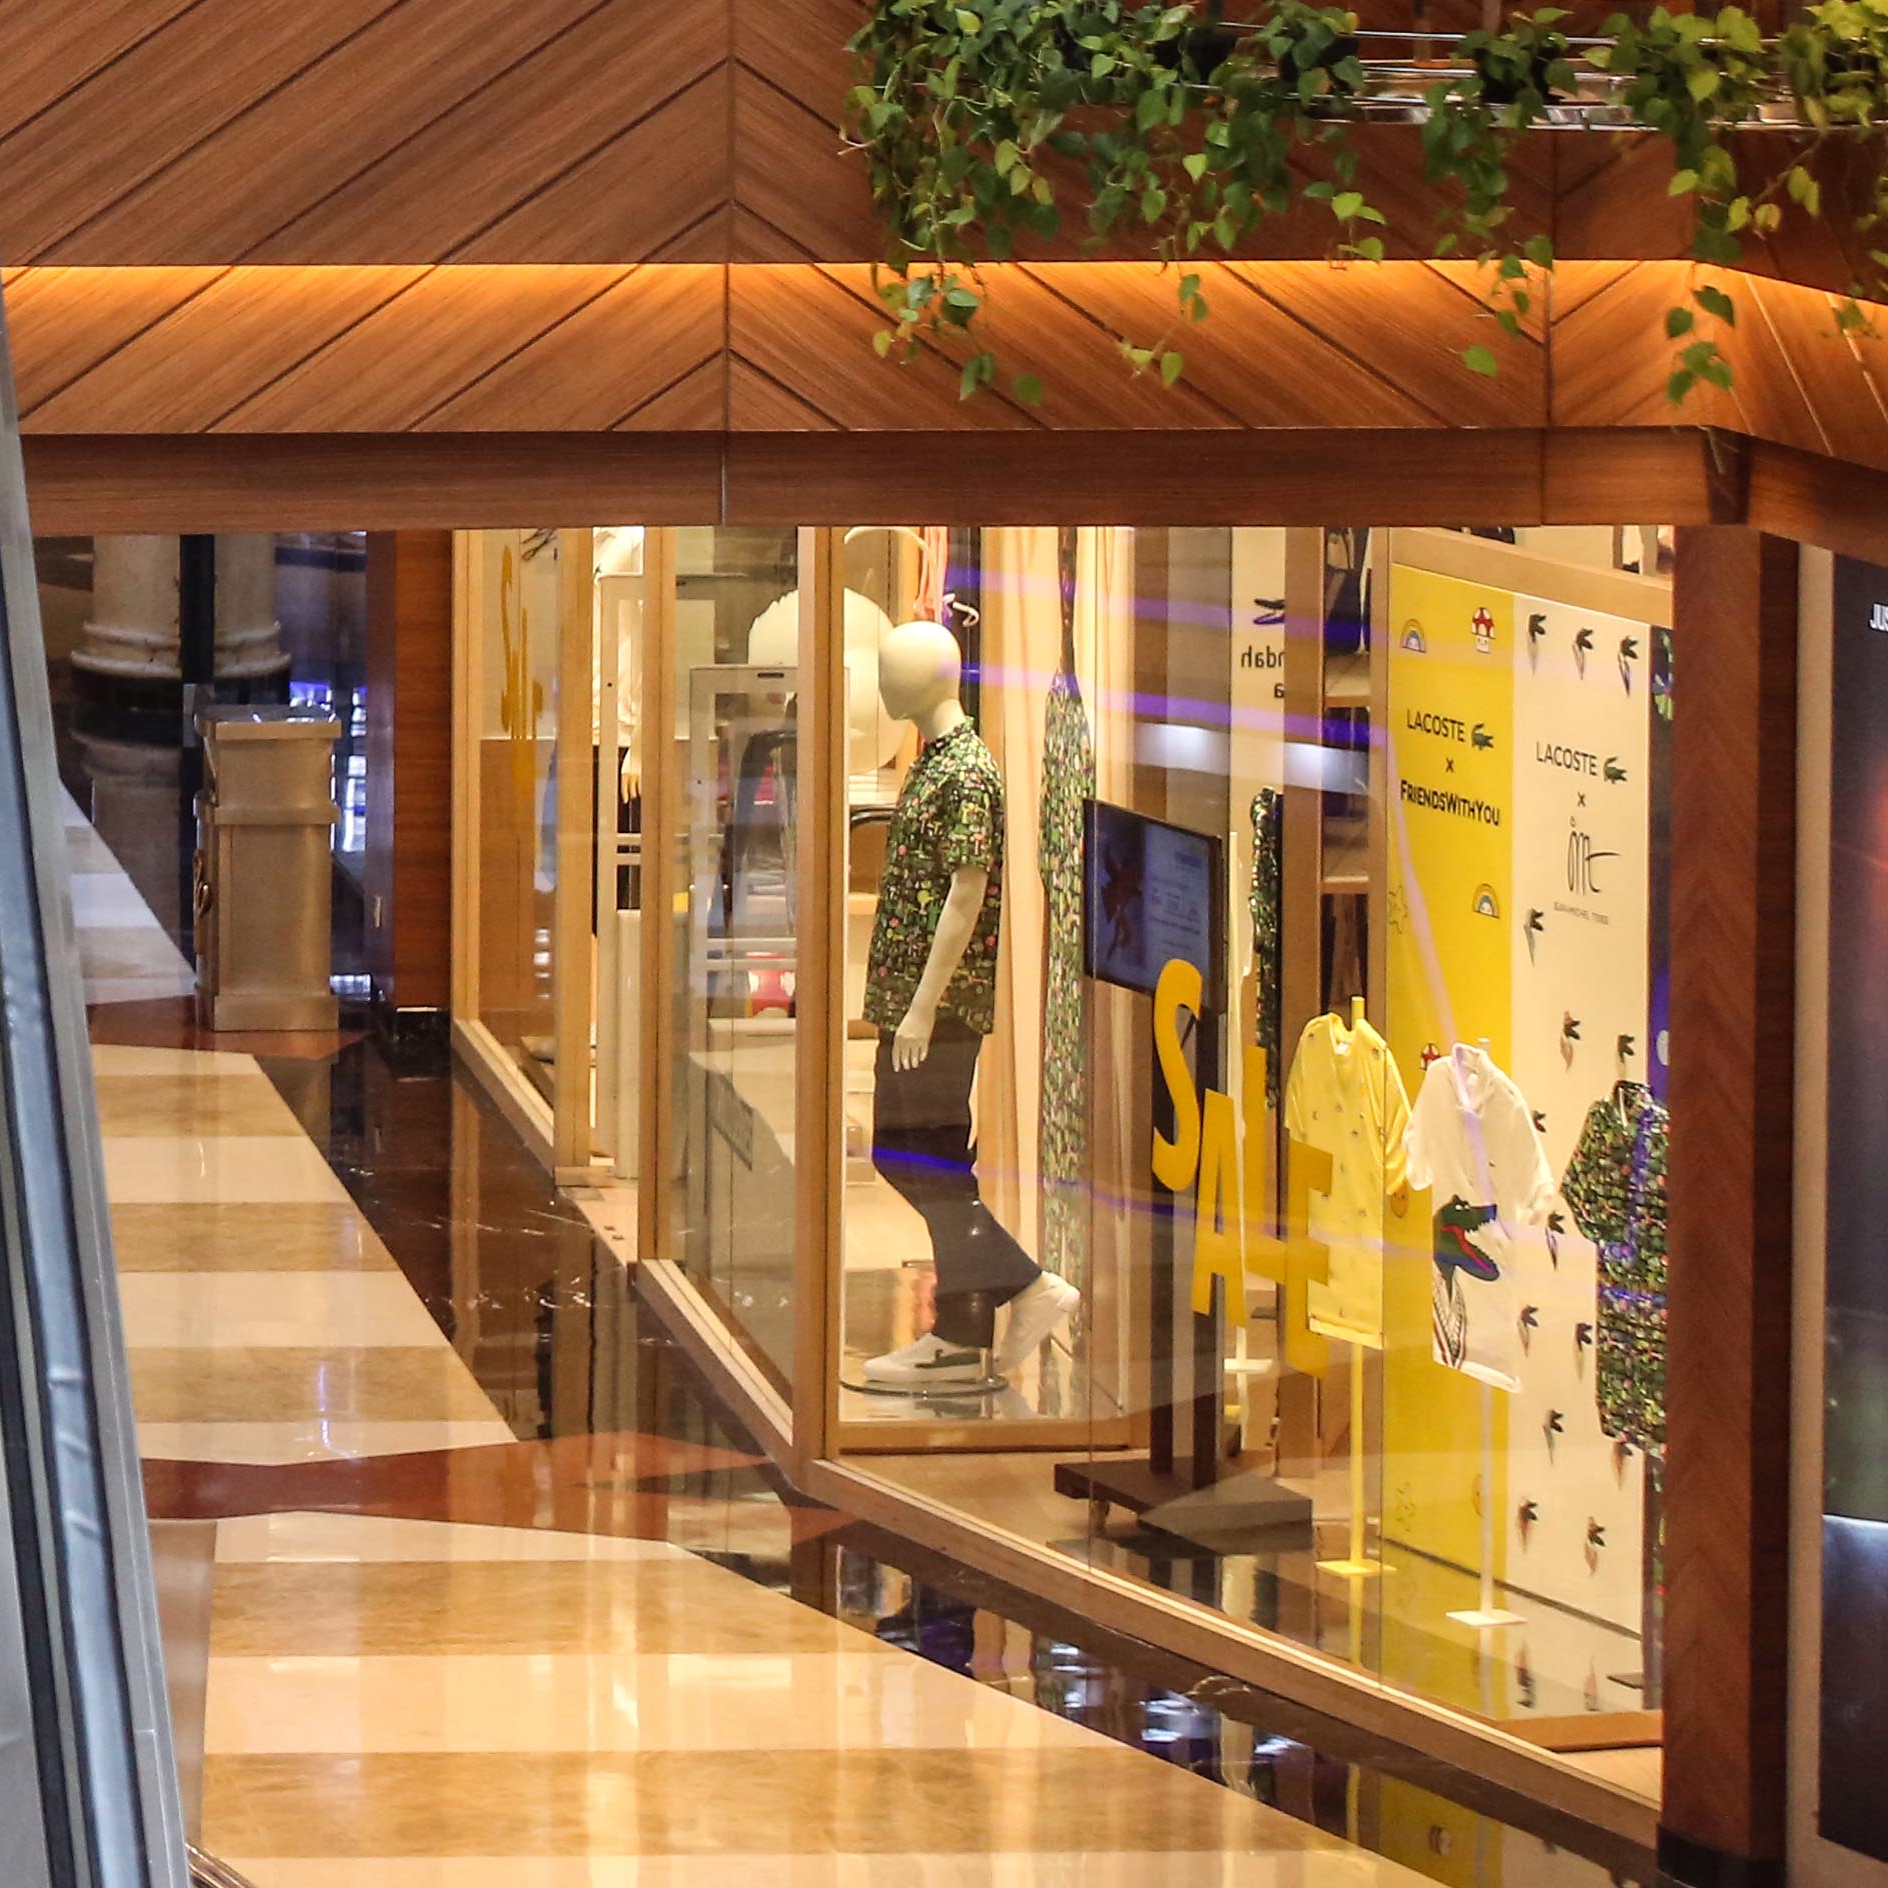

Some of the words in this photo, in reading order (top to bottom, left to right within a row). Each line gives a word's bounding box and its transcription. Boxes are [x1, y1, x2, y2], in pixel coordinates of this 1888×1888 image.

[1406, 708, 1466, 743] LACOSTE
[1535, 741, 1598, 776] LACOSTE
[1152, 957, 1333, 1381] SALE
